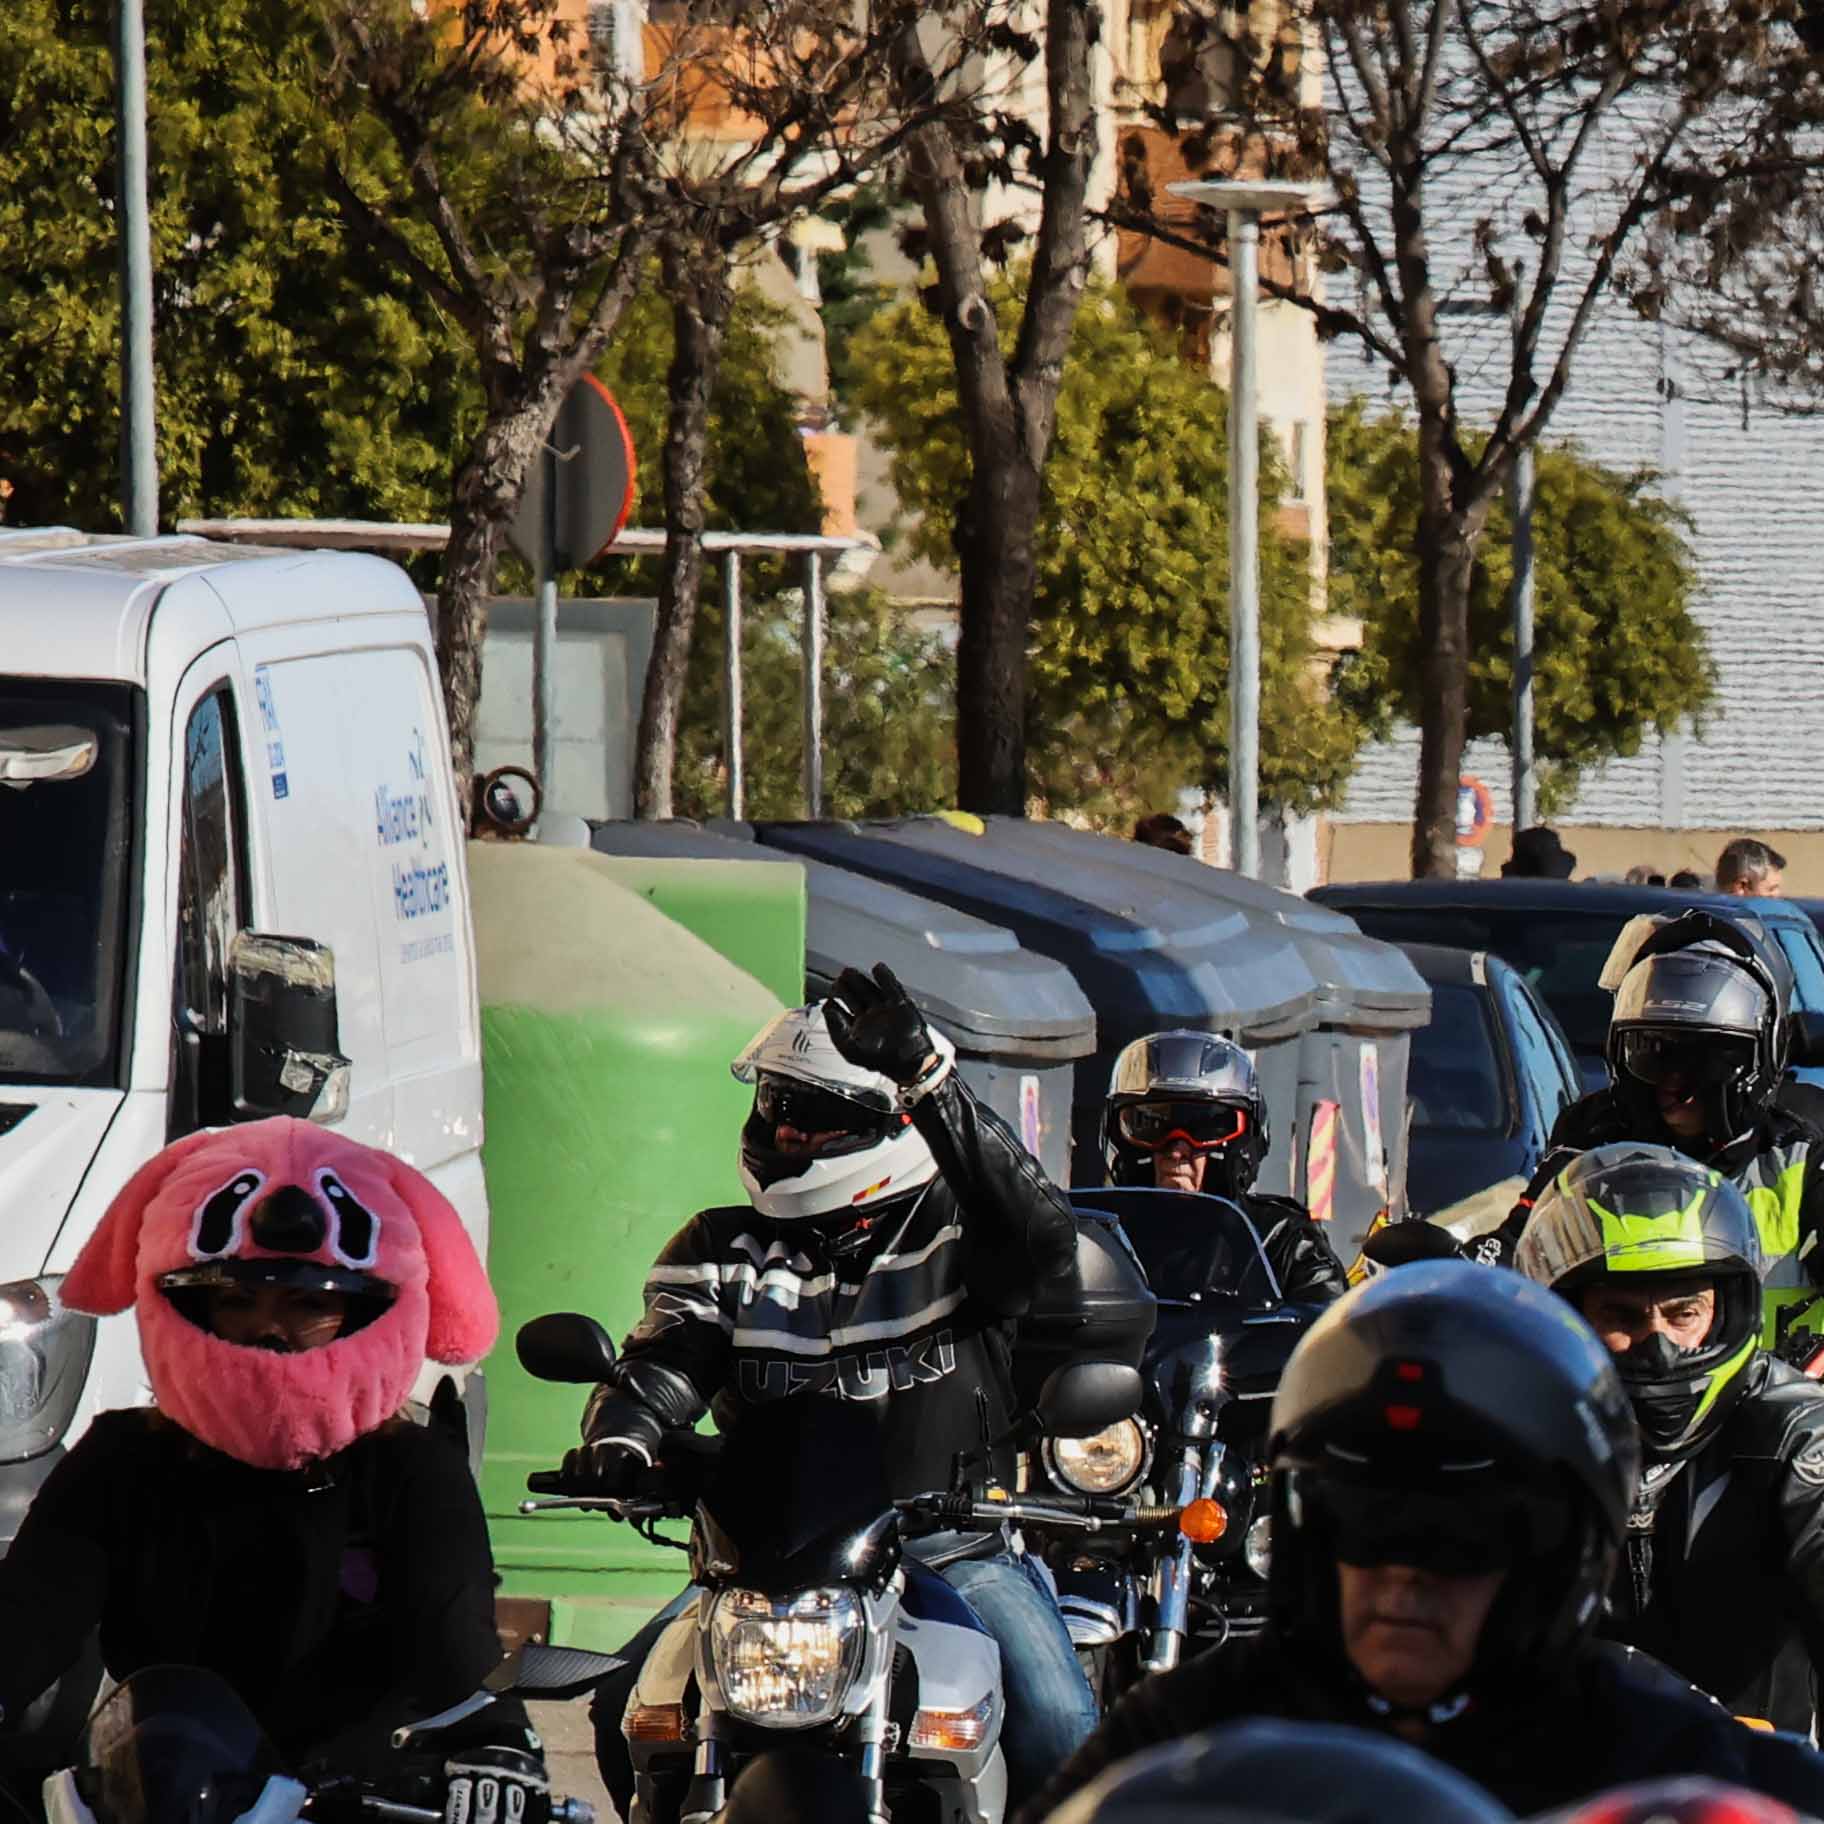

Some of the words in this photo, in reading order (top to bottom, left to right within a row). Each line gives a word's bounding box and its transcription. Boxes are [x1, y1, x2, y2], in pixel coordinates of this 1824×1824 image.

[376, 785, 417, 846] Alliance
[393, 857, 449, 920] Healthcare
[738, 1329, 956, 1402] UZUKI
